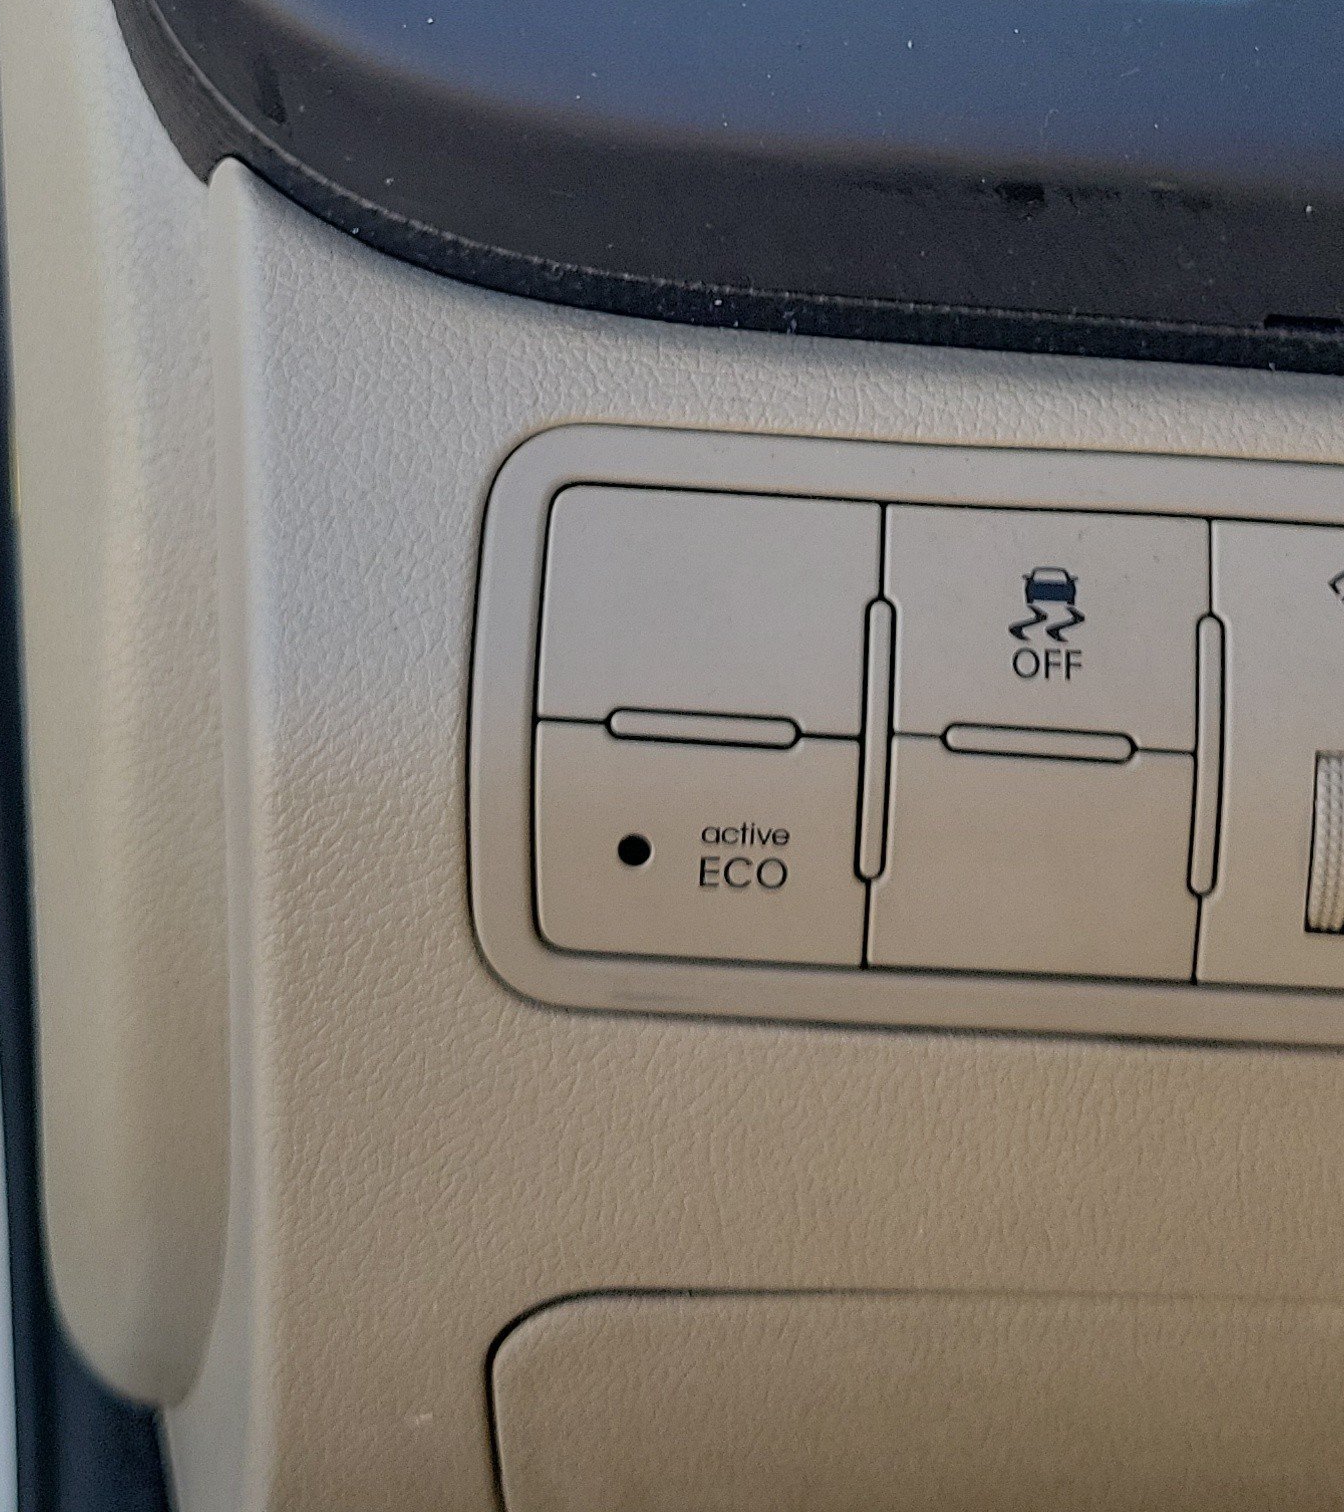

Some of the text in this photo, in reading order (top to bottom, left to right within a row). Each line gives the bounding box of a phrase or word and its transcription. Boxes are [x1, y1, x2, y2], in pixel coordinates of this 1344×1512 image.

[1012, 647, 1083, 680] OFF
[701, 822, 790, 846] active
[699, 856, 788, 889] ECO
